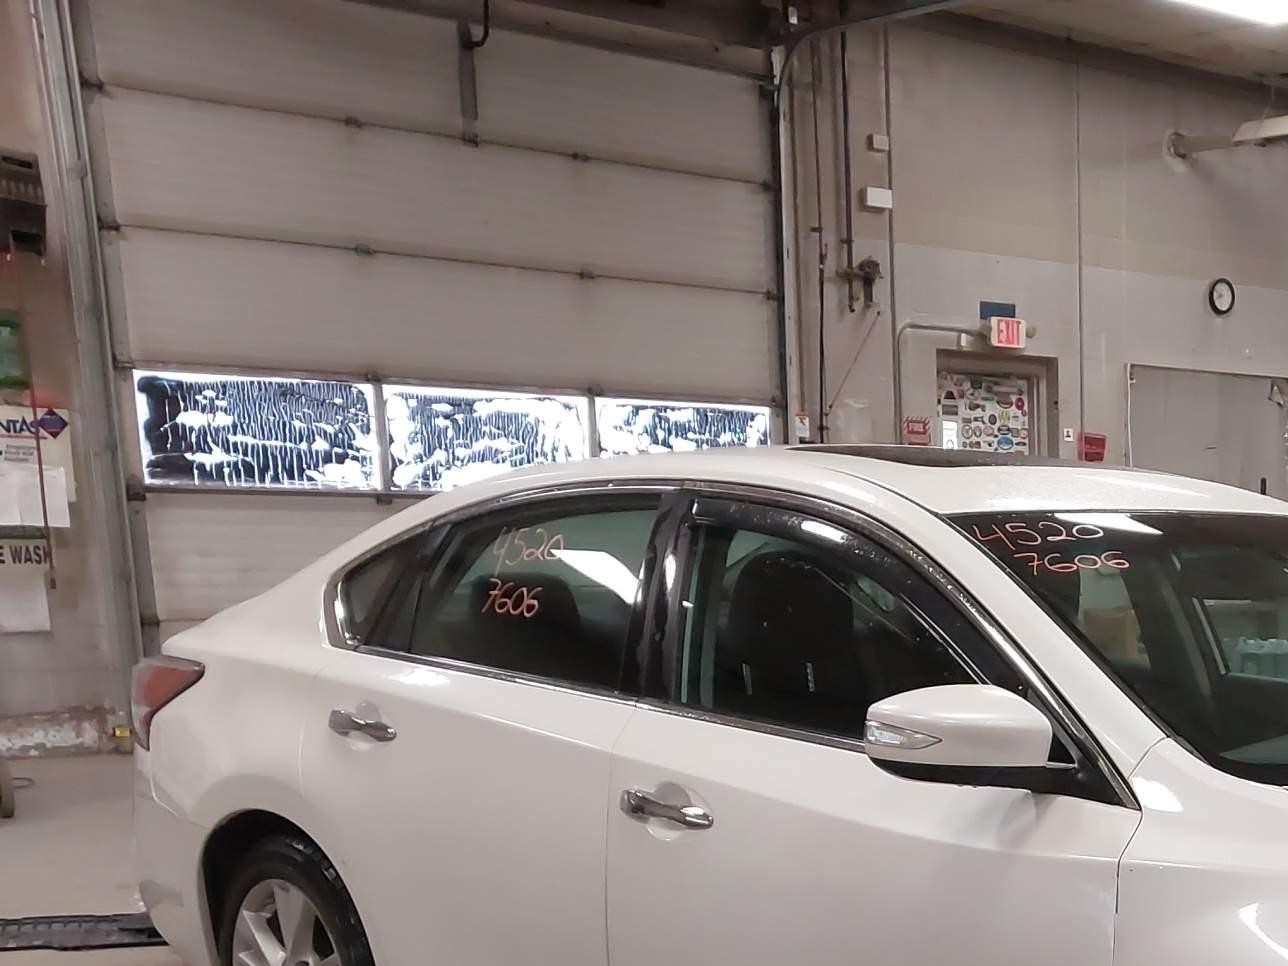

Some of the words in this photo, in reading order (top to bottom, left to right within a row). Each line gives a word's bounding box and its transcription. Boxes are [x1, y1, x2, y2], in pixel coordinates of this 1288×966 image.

[997, 319, 1022, 346] EXIT
[972, 521, 1104, 550] 4520
[493, 527, 565, 577] 4520
[1013, 551, 1130, 576] 7606
[481, 578, 543, 618] 7606
